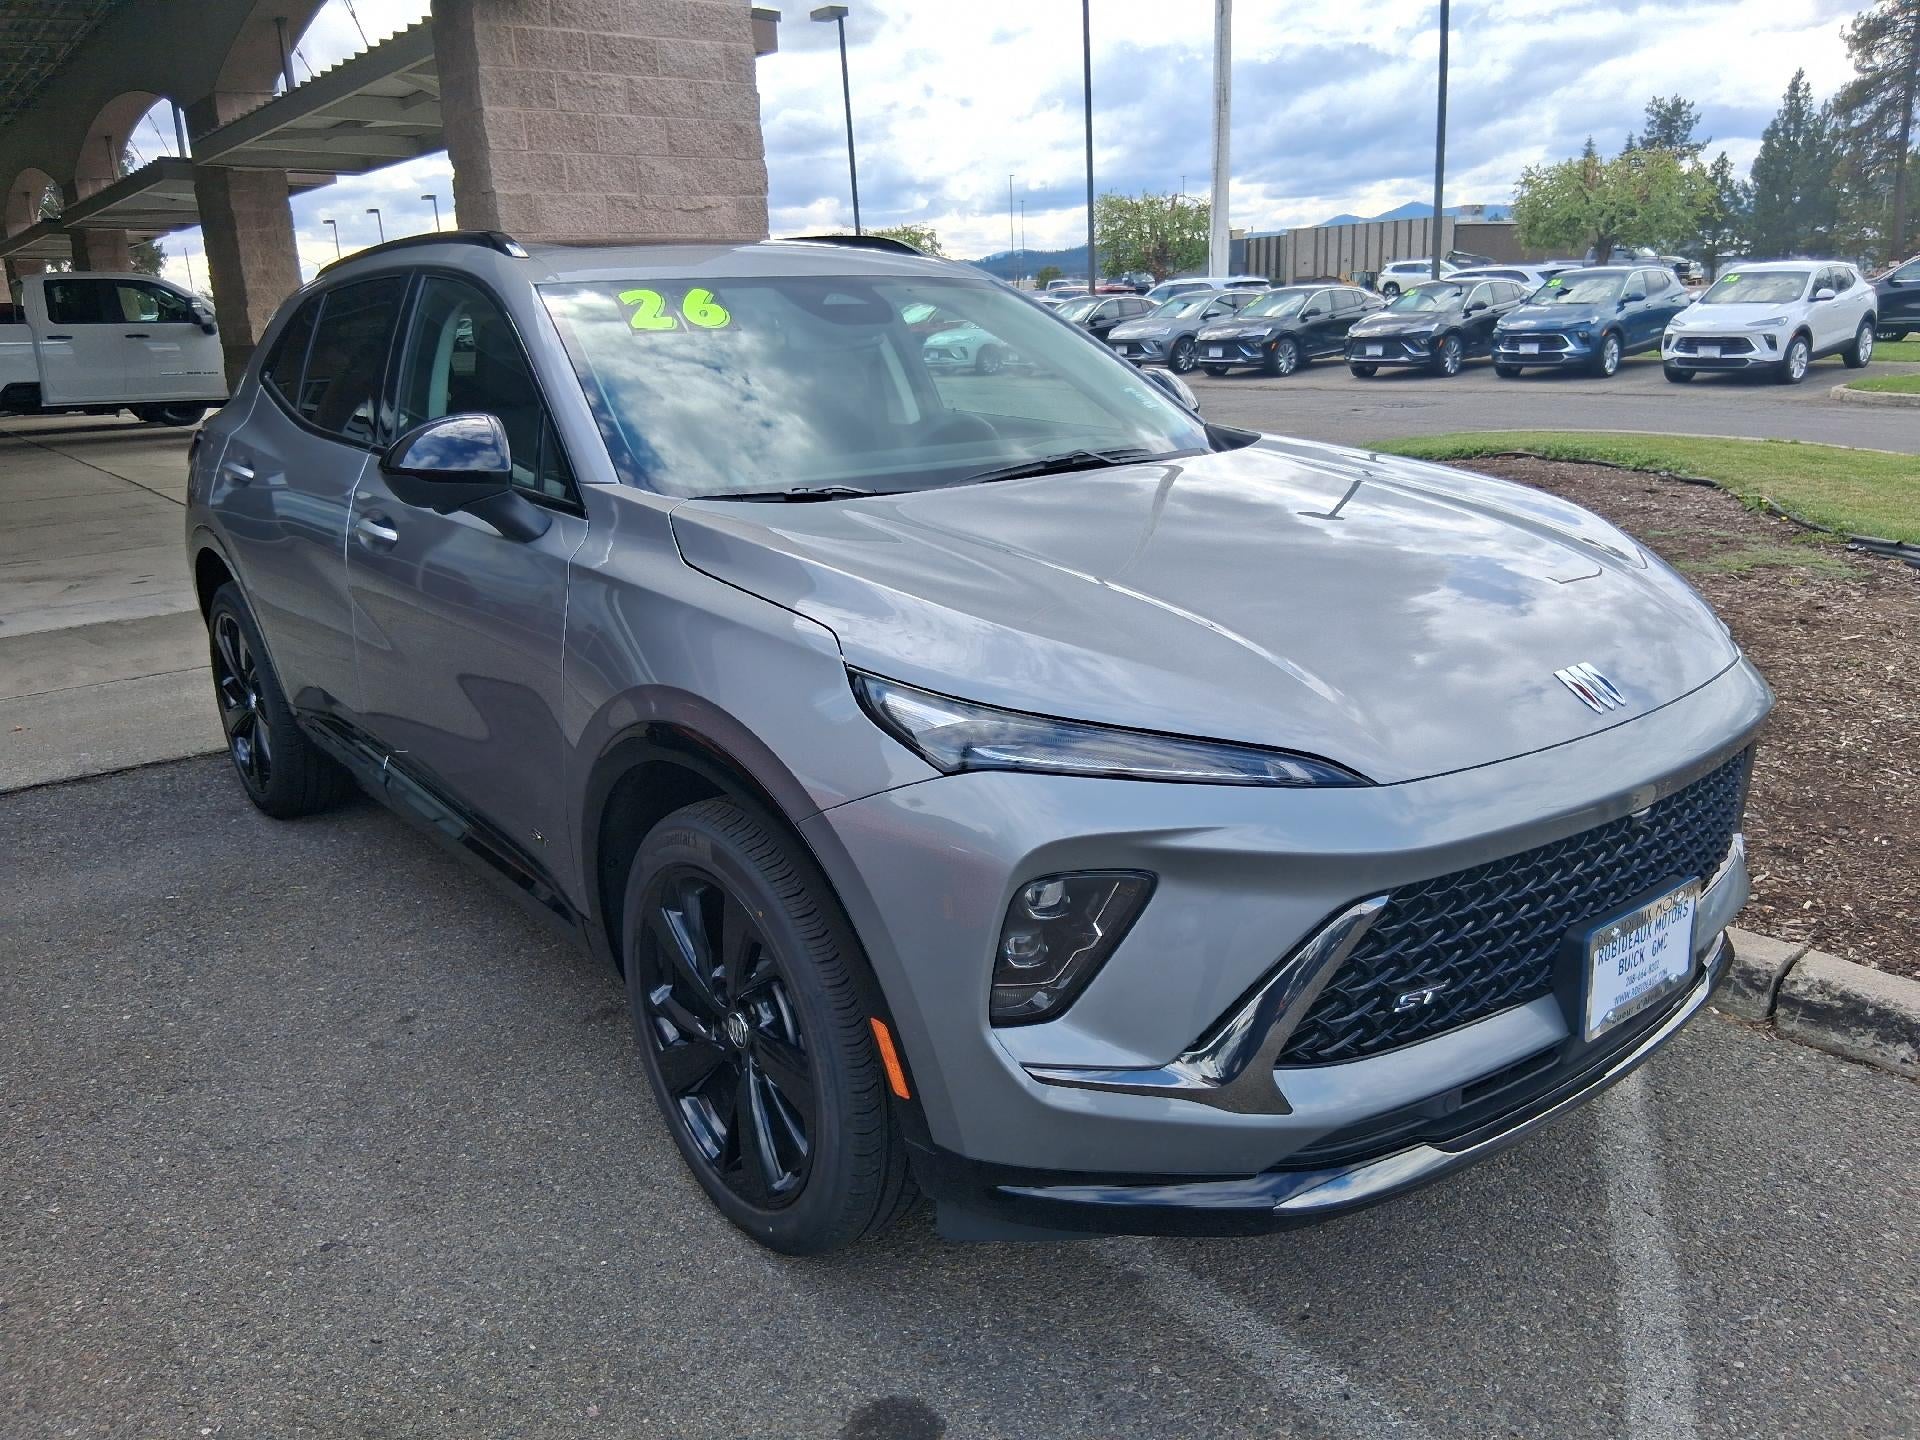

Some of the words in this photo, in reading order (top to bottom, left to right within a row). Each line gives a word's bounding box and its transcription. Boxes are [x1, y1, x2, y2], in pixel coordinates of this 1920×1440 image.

[618, 288, 731, 330] 26
[1597, 920, 1654, 966] ROBIDEAUX
[1654, 899, 1689, 934] MOTORS
[1618, 946, 1645, 976] BUICK
[1651, 932, 1669, 957] GMC
